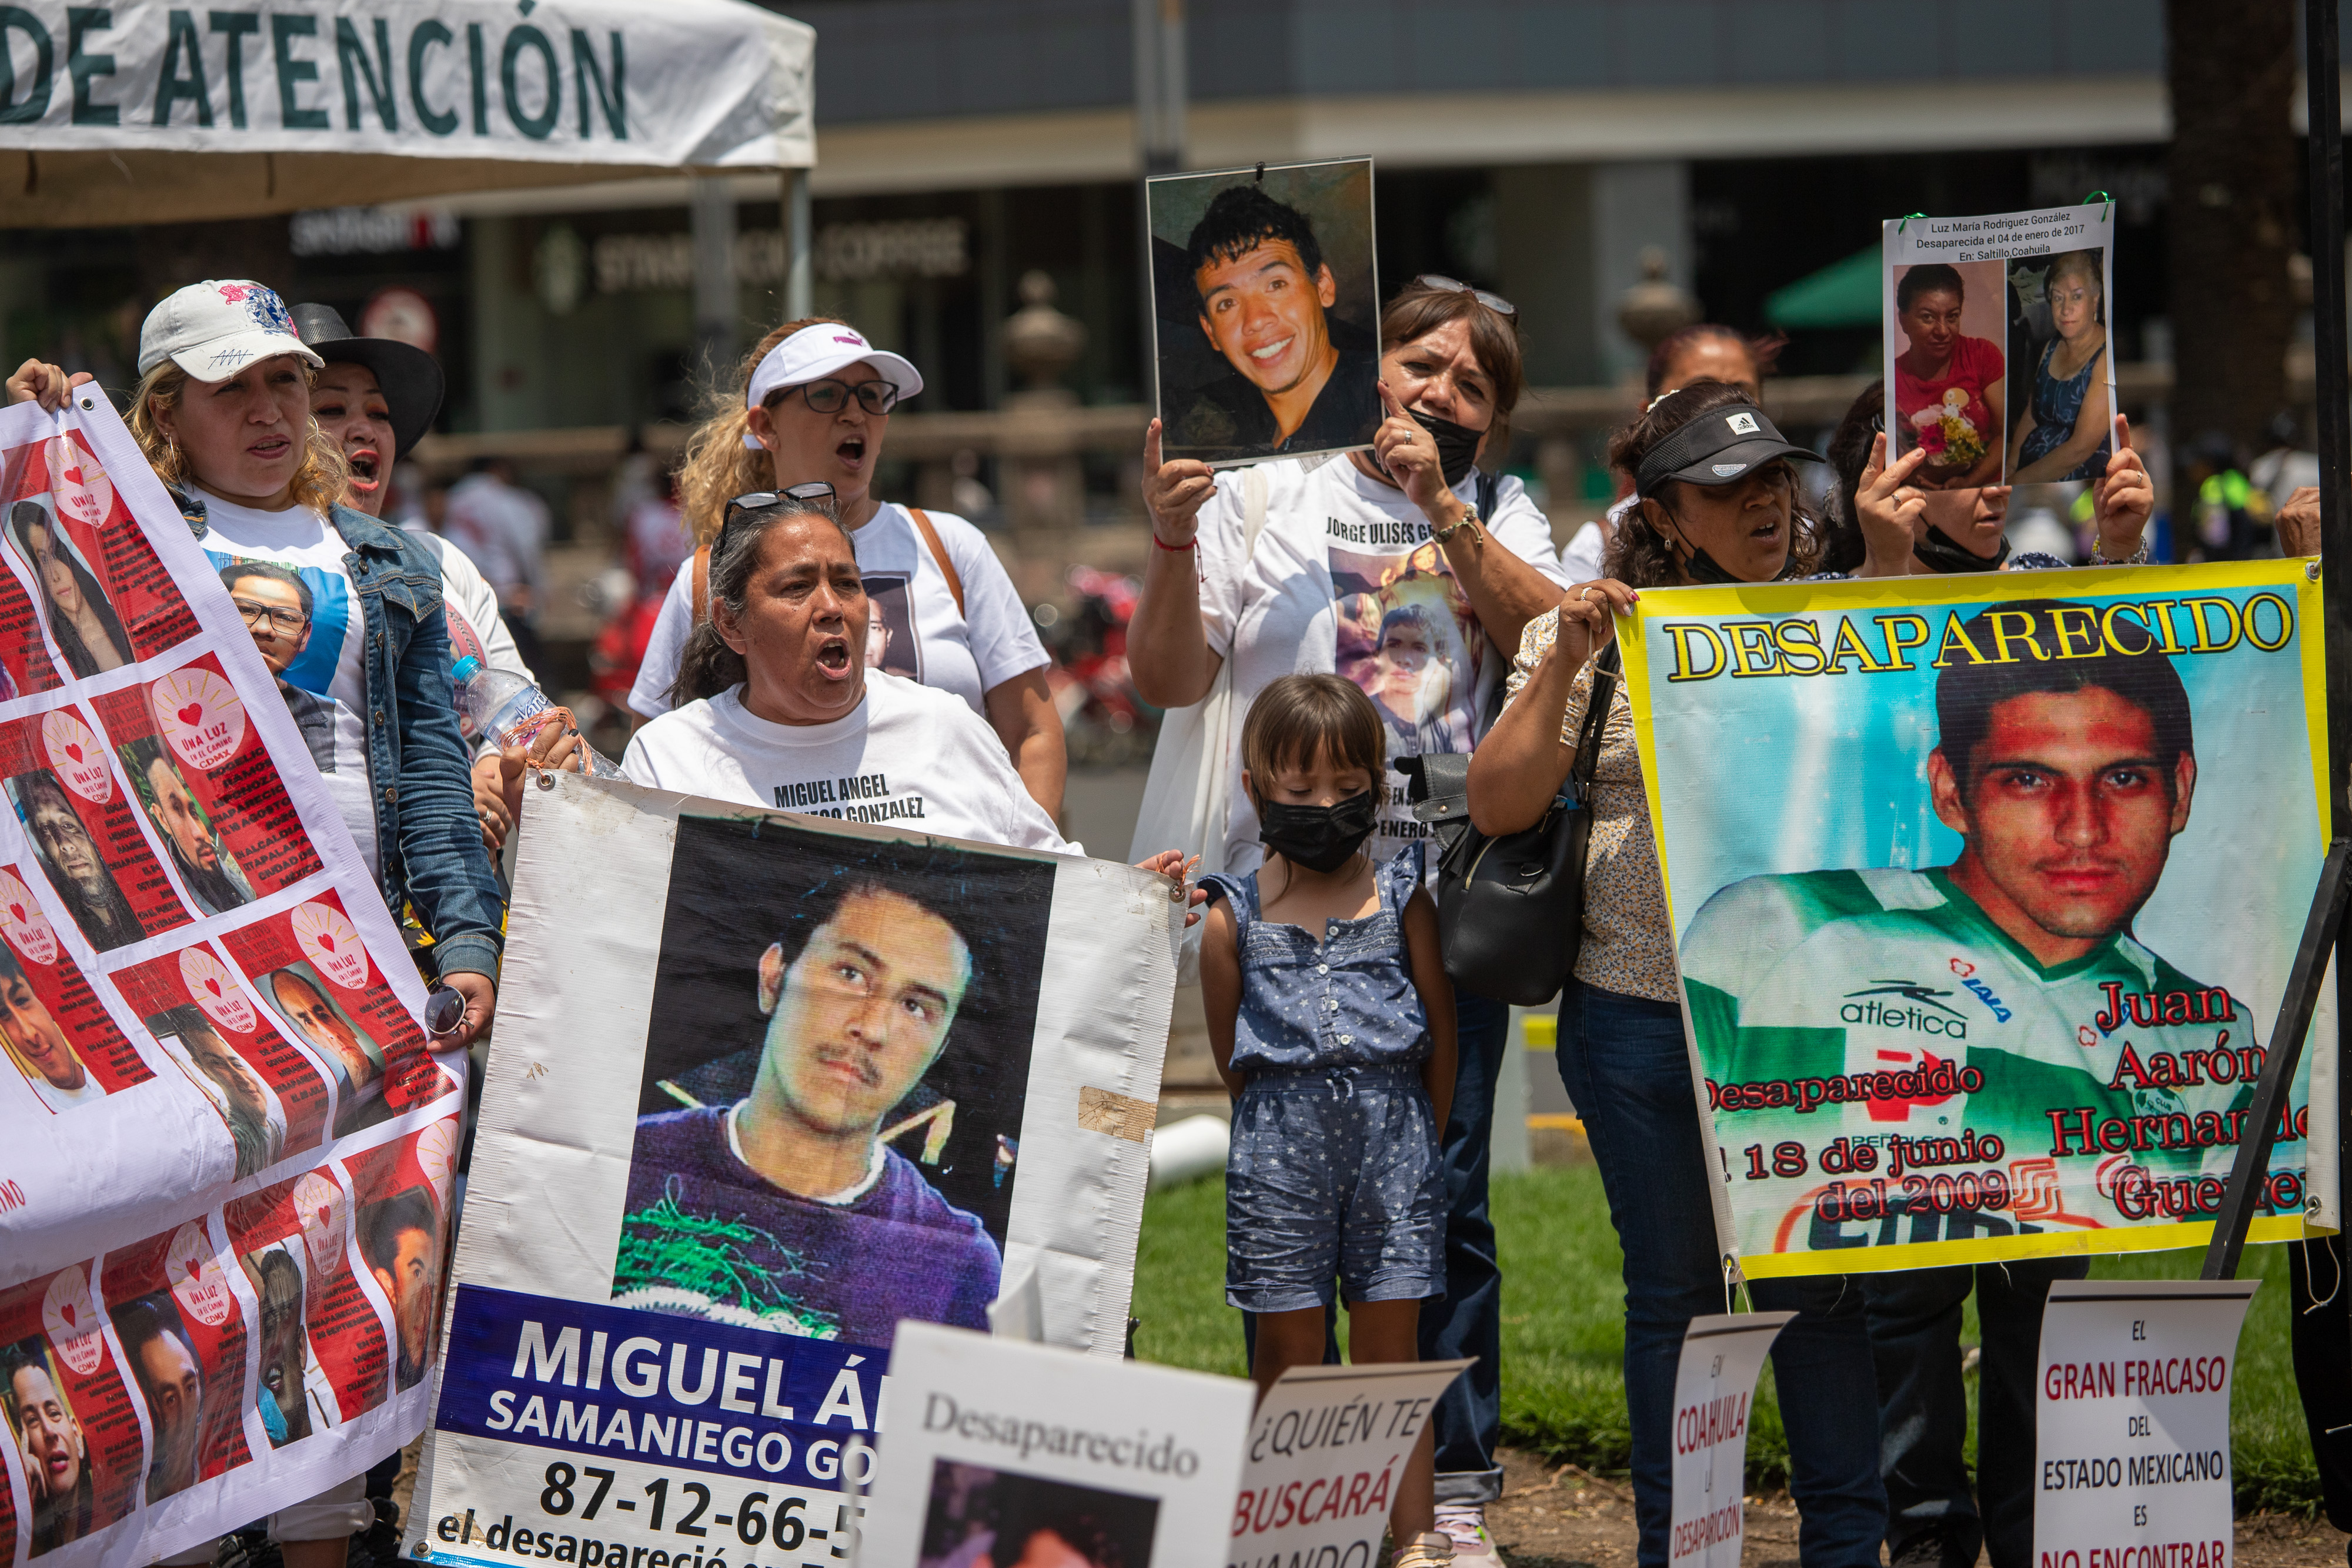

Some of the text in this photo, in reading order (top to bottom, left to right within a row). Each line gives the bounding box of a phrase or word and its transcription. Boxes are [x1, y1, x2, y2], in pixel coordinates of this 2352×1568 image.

[151, 0, 629, 141] ATENCIÓN
[1932, 212, 2070, 233] Luz María Rodriguez González
[1917, 224, 2085, 249] Desaparecida el 04 de enero de 2017
[1960, 252, 1975, 261] En:
[1327, 516, 1366, 543] JORGE
[1369, 523, 1415, 544] ULISES
[1662, 591, 2296, 683] DESAPARECIDO
[205, 722, 228, 741] LUZ
[199, 748, 232, 769] CDMX
[88, 766, 104, 780] LUZ
[774, 774, 890, 808] MIGUEL ANGEL
[847, 797, 925, 823] GONZALEZ
[1380, 820, 1428, 838] ENERO
[31, 928, 46, 941] LUZ
[38, 954, 55, 964] CDMX
[341, 954, 357, 967] LUZ
[348, 978, 365, 988] CDMX
[229, 1000, 244, 1013] LUZ
[2095, 981, 2237, 1032] Juan
[236, 1022, 255, 1033] CDMX
[1840, 1001, 1966, 1039] atletica
[2107, 1030, 2267, 1092] Aarón
[1745, 1141, 1809, 1179] 18
[1819, 1137, 1878, 1174] de
[1887, 1128, 2005, 1178] junio
[1817, 1170, 2010, 1222] del 2009
[203, 1285, 218, 1299] LUZ
[205, 1311, 225, 1325] CDMX
[2132, 1320, 2146, 1340] EL
[79, 1332, 92, 1348] LUZ
[78, 1360, 97, 1373] CDMX
[512, 1320, 793, 1420] MIGUEL
[2044, 1356, 2226, 1400] GRAN FRACASO
[486, 1391, 792, 1472] SAMANIEGO
[922, 1392, 1200, 1480] Desaparecido
[1251, 1393, 1432, 1463] ¿QUIÉN TE
[1677, 1391, 1747, 1455] COAHUILA
[2129, 1415, 2151, 1437] DEL
[2043, 1450, 2223, 1490] ESTADO MEXICANO
[1232, 1454, 1399, 1537] BUSCARÁ
[1674, 1496, 1740, 1559] DESAPARICIÓN
[2134, 1505, 2147, 1526] ES
[438, 1509, 727, 1568] el desapareció
[2089, 1540, 2224, 1568] ENCONTRAR
